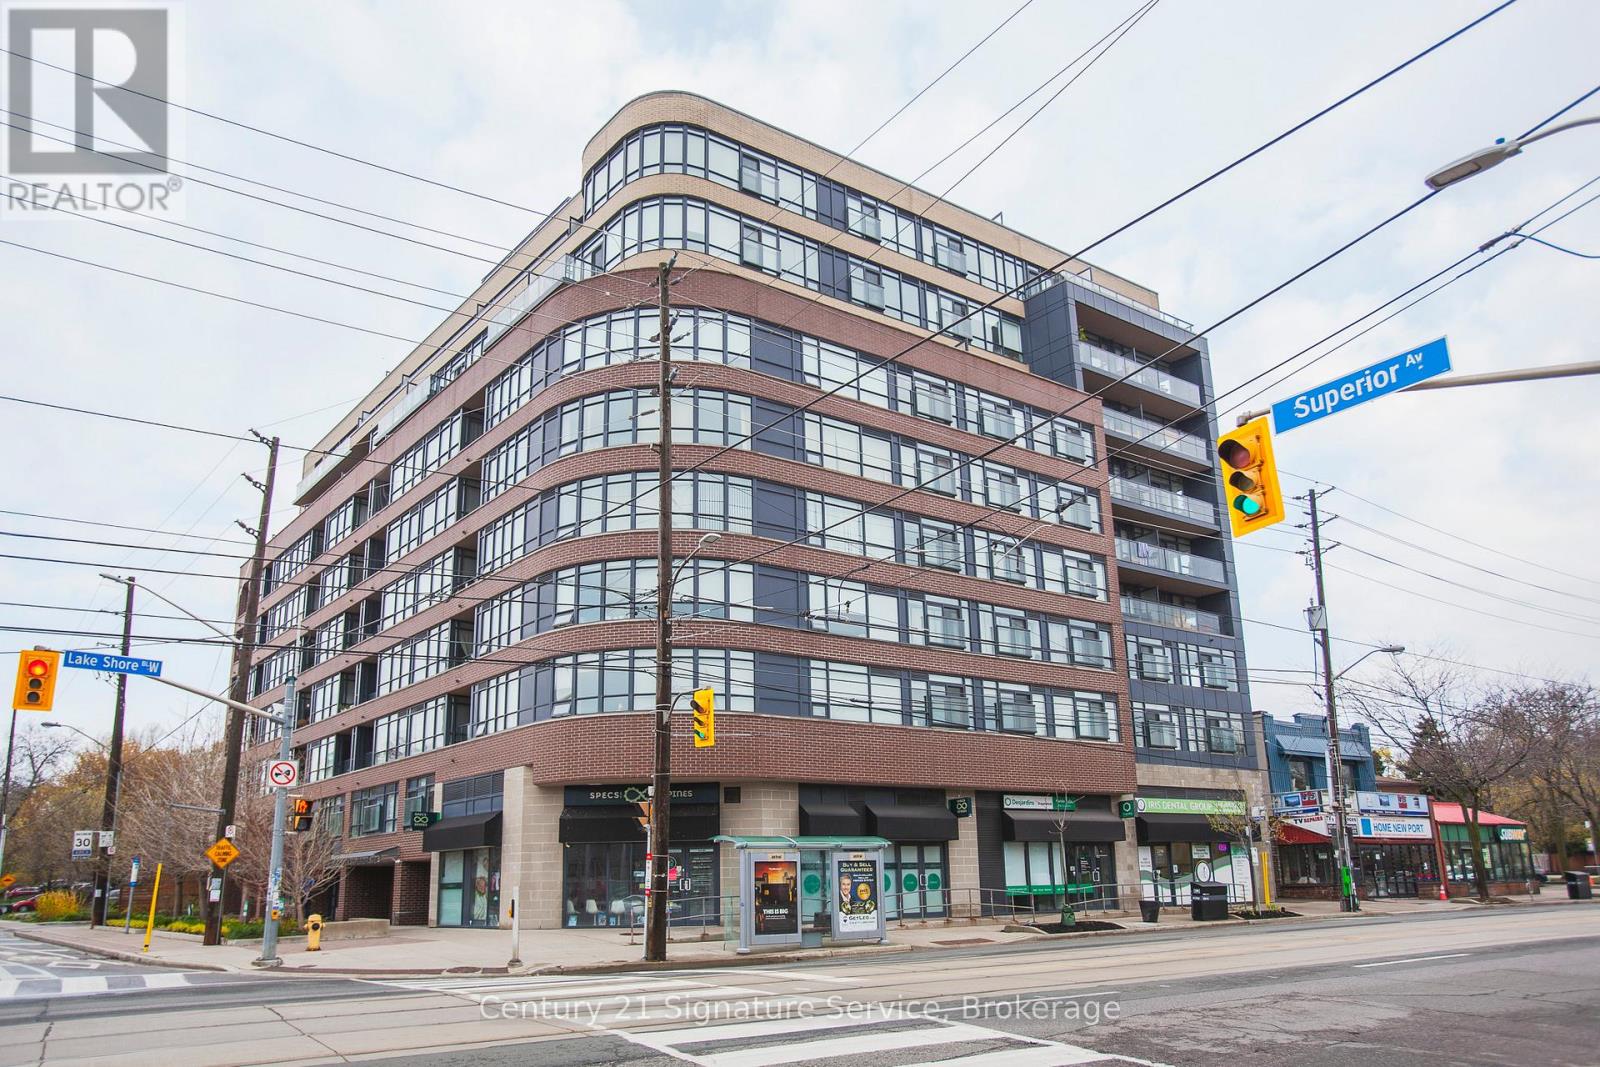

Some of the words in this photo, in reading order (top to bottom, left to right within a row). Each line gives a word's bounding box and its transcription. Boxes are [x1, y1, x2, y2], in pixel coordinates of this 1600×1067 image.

[1294, 363, 1400, 419] Superior
[1405, 352, 1423, 368] Av
[68, 652, 98, 667] Lake
[103, 656, 139, 671] Shore
[149, 661, 160, 673] W
[590, 791, 620, 799] SPECS
[1147, 800, 1160, 809] IRIS
[1163, 801, 1187, 810] DENTAL
[1374, 823, 1392, 832] HOME
[1393, 823, 1407, 833] NEW
[1408, 824, 1424, 833] PORT
[1500, 828, 1526, 841] SUBWAY
[75, 838, 91, 848] 30
